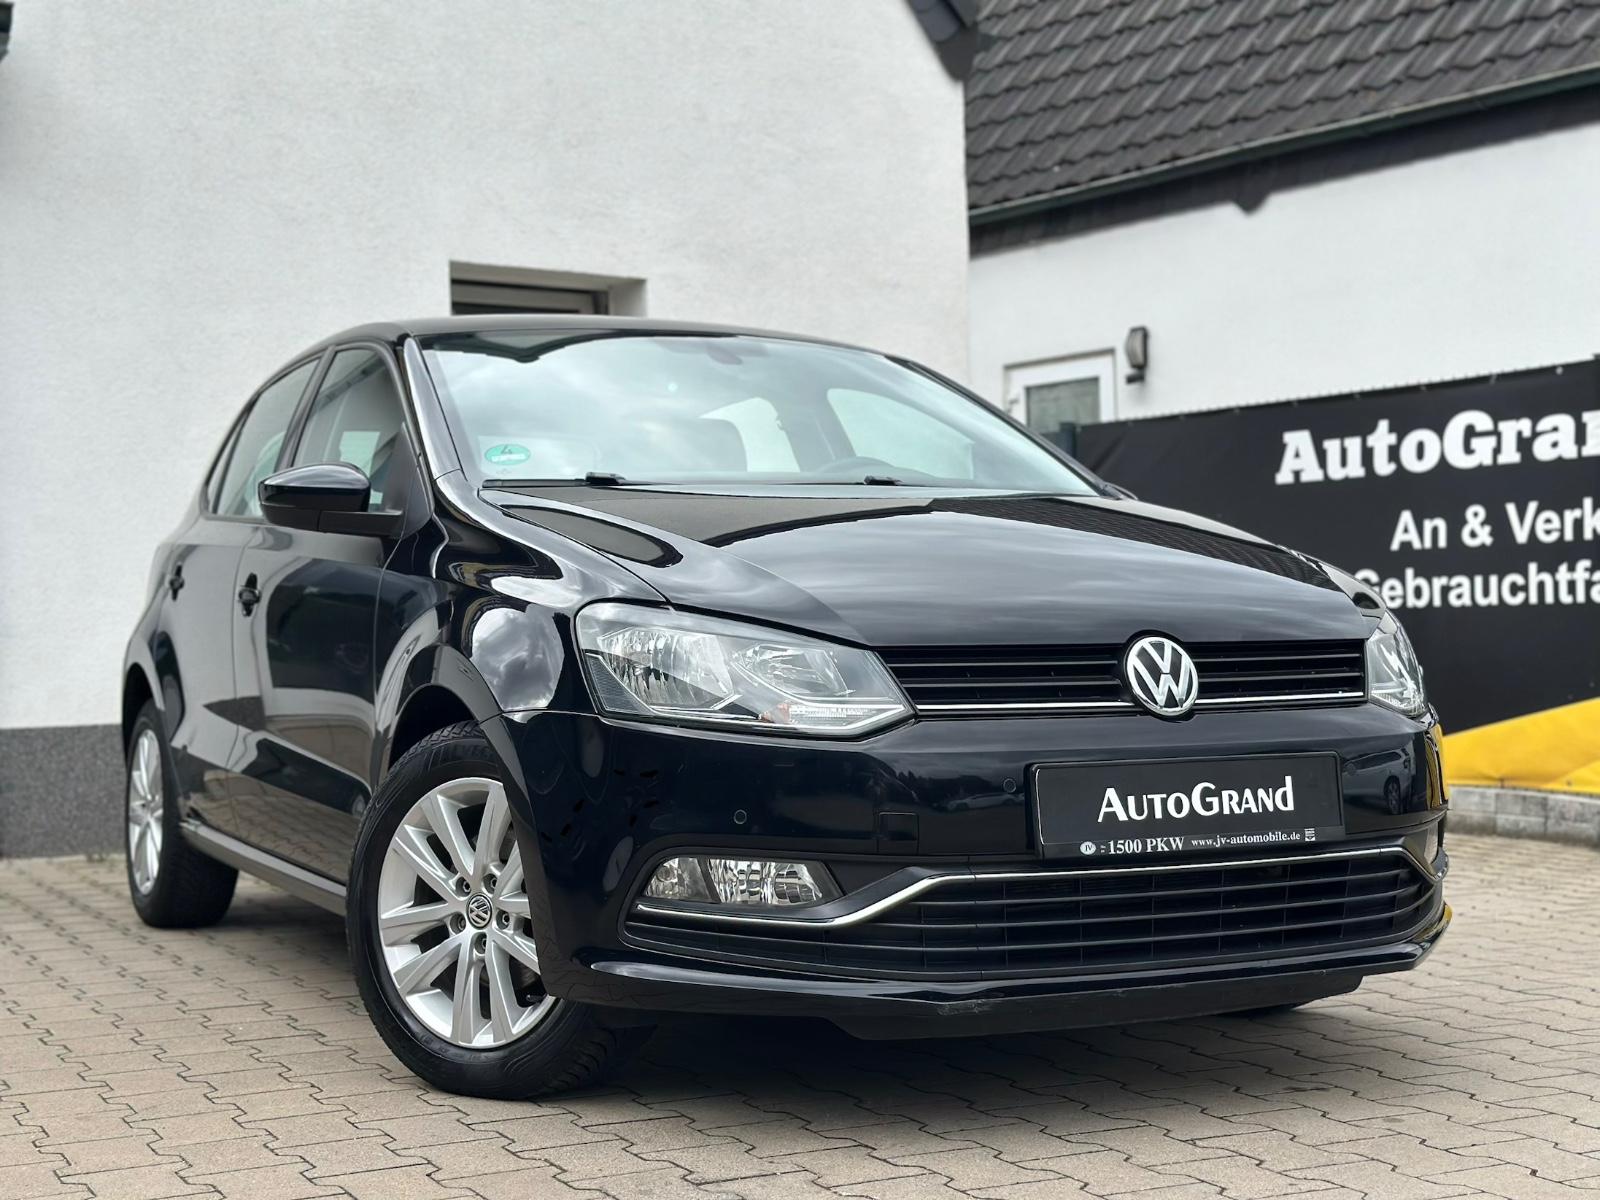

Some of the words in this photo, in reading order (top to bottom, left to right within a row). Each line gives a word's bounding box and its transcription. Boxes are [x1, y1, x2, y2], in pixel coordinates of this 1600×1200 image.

[1390, 509, 1448, 551] An
[1460, 504, 1494, 547] &
[1108, 838, 1143, 855] 1500
[1146, 836, 1185, 853] PKW
[1191, 831, 1301, 848] www.jv-automobile.de
